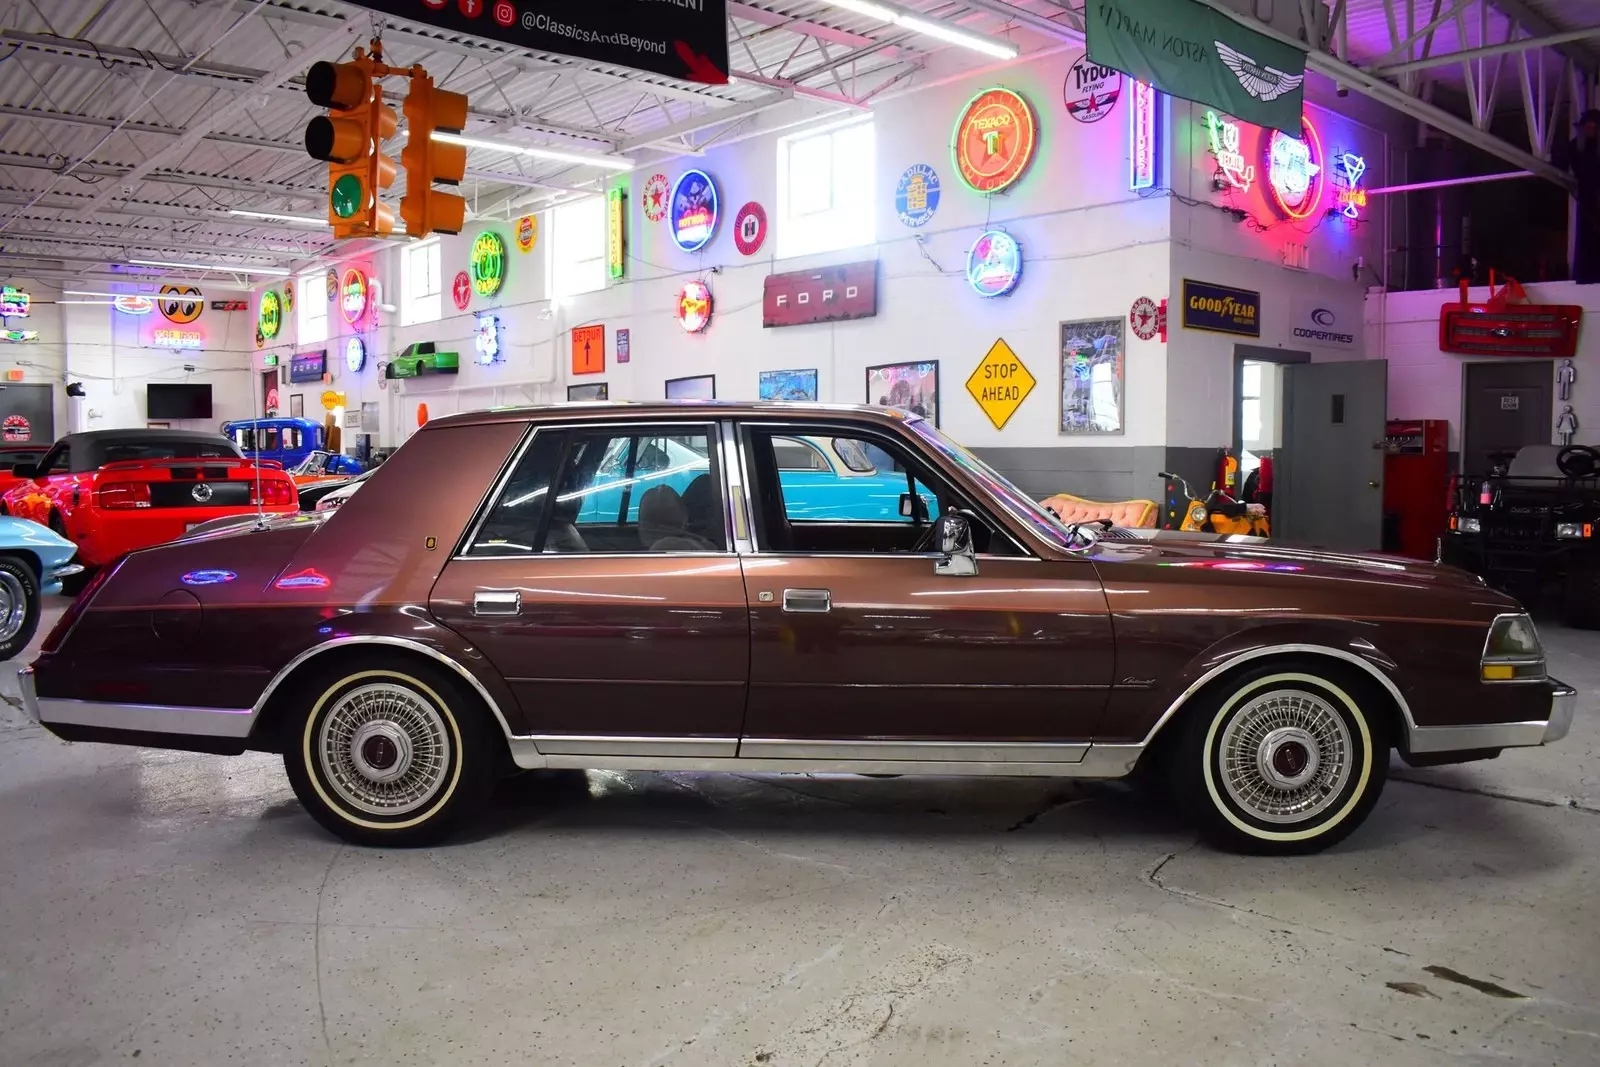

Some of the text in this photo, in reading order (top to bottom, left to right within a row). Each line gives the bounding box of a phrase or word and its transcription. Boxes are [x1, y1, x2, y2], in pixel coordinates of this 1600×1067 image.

[521, 11, 667, 55] @ClassicsAndBeyond
[1082, 81, 1104, 93] FLYING
[971, 114, 1010, 129] TEXACO
[898, 165, 938, 190] CADILLAC
[899, 206, 935, 227] SERVICE
[776, 286, 858, 307] FORD
[573, 328, 601, 343] DETOUR
[293, 363, 319, 372] FORD
[984, 363, 1018, 379] STOP
[981, 385, 1020, 402] AHEAD
